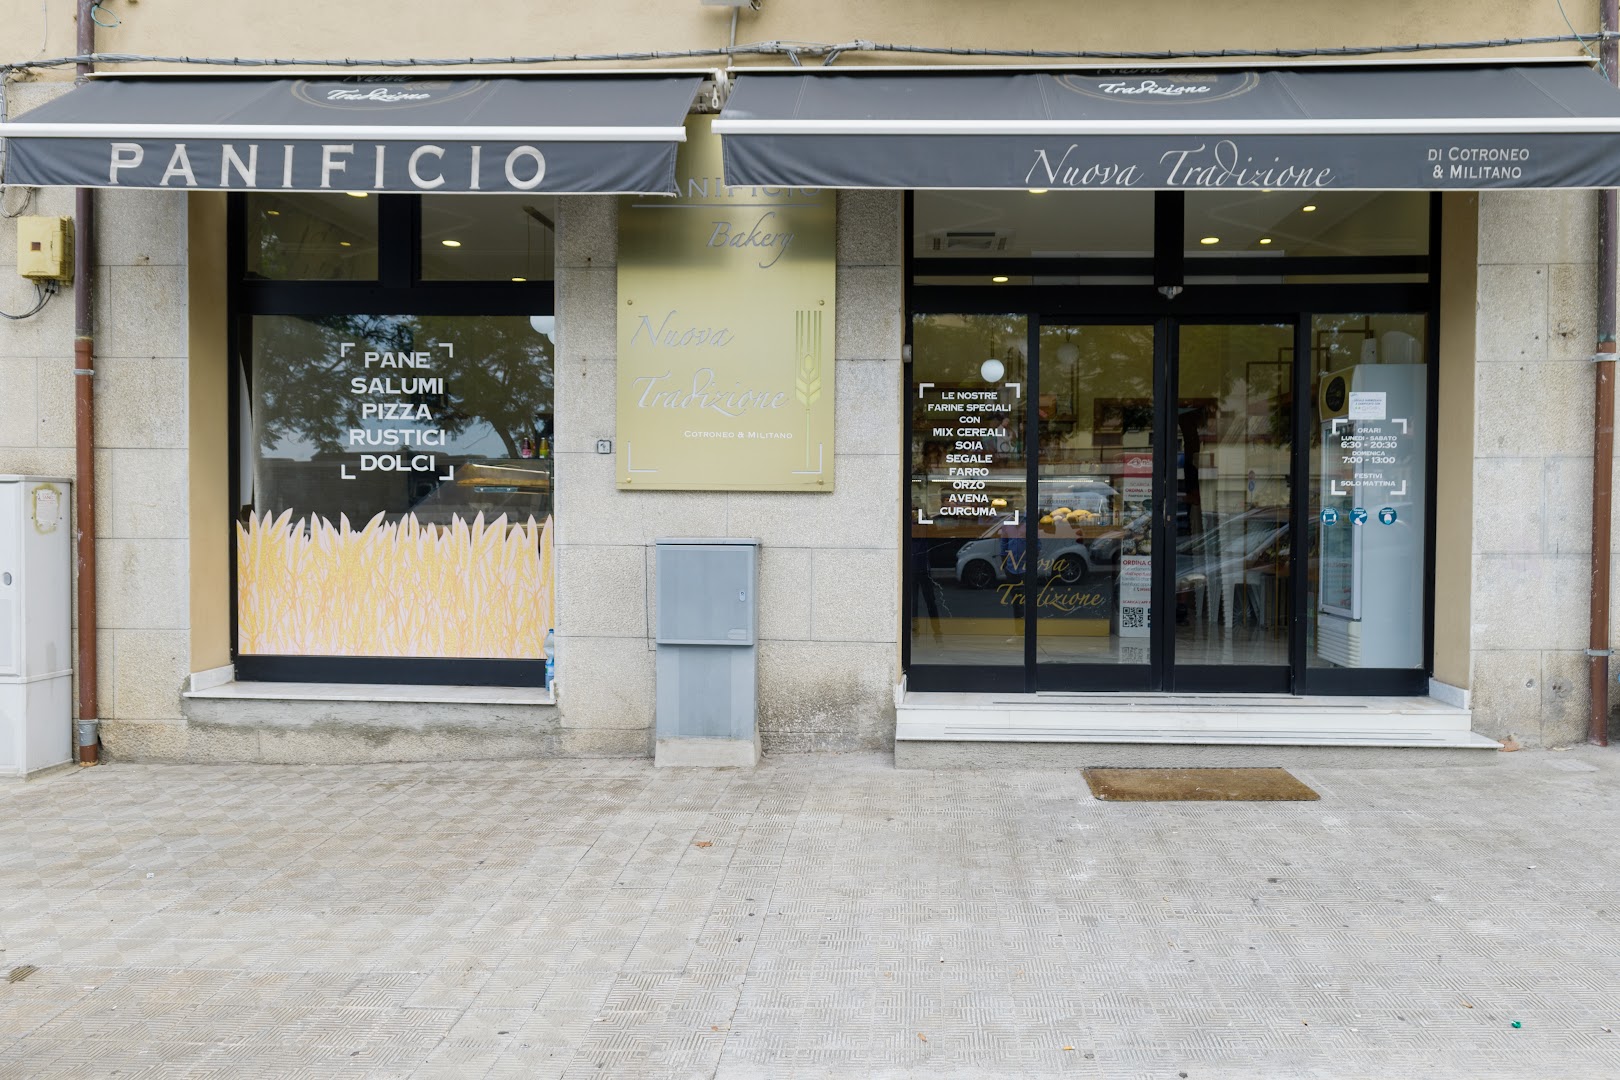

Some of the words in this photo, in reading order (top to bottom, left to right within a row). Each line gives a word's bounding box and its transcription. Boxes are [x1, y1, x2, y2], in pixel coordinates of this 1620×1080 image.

[1098, 80, 1211, 96] Tradizione
[1427, 148, 1442, 161] DI
[1448, 146, 1530, 161] COTRONEO
[108, 141, 548, 191] PANIFICIO
[1025, 143, 1144, 187] Nuova
[1159, 139, 1336, 188] Tradizione
[1432, 164, 1444, 179] &
[1449, 164, 1522, 179] MILITANO
[706, 211, 795, 269] Bakery
[630, 309, 736, 348] Nuova
[364, 351, 431, 369] PANE
[350, 377, 444, 395] SALUMI
[632, 367, 790, 418] Tradizione
[941, 391, 955, 400] LE
[957, 391, 998, 400] NOSTRE
[362, 403, 432, 420] PIZZA
[927, 403, 964, 412] FARINE
[966, 403, 1012, 412] SPECIALI
[959, 415, 981, 424] CON
[349, 428, 445, 446] RUSTICI
[683, 430, 735, 439] COTRONEO
[737, 431, 745, 439] &
[747, 431, 793, 440] MILITANO
[932, 427, 954, 437] MIX
[956, 427, 1006, 437] CEREALI
[955, 440, 983, 450] SOIA
[1340, 441, 1362, 449] 6:30
[1370, 441, 1398, 449] 20:30
[360, 454, 435, 472] DOLCI
[945, 454, 993, 464] SEGALE
[1342, 456, 1363, 464] 7:00
[1371, 456, 1396, 464] 13:00
[949, 467, 989, 477] FARRO
[952, 481, 986, 490] ORZO
[948, 493, 989, 503] AVENA
[939, 506, 997, 516] CURCUMA
